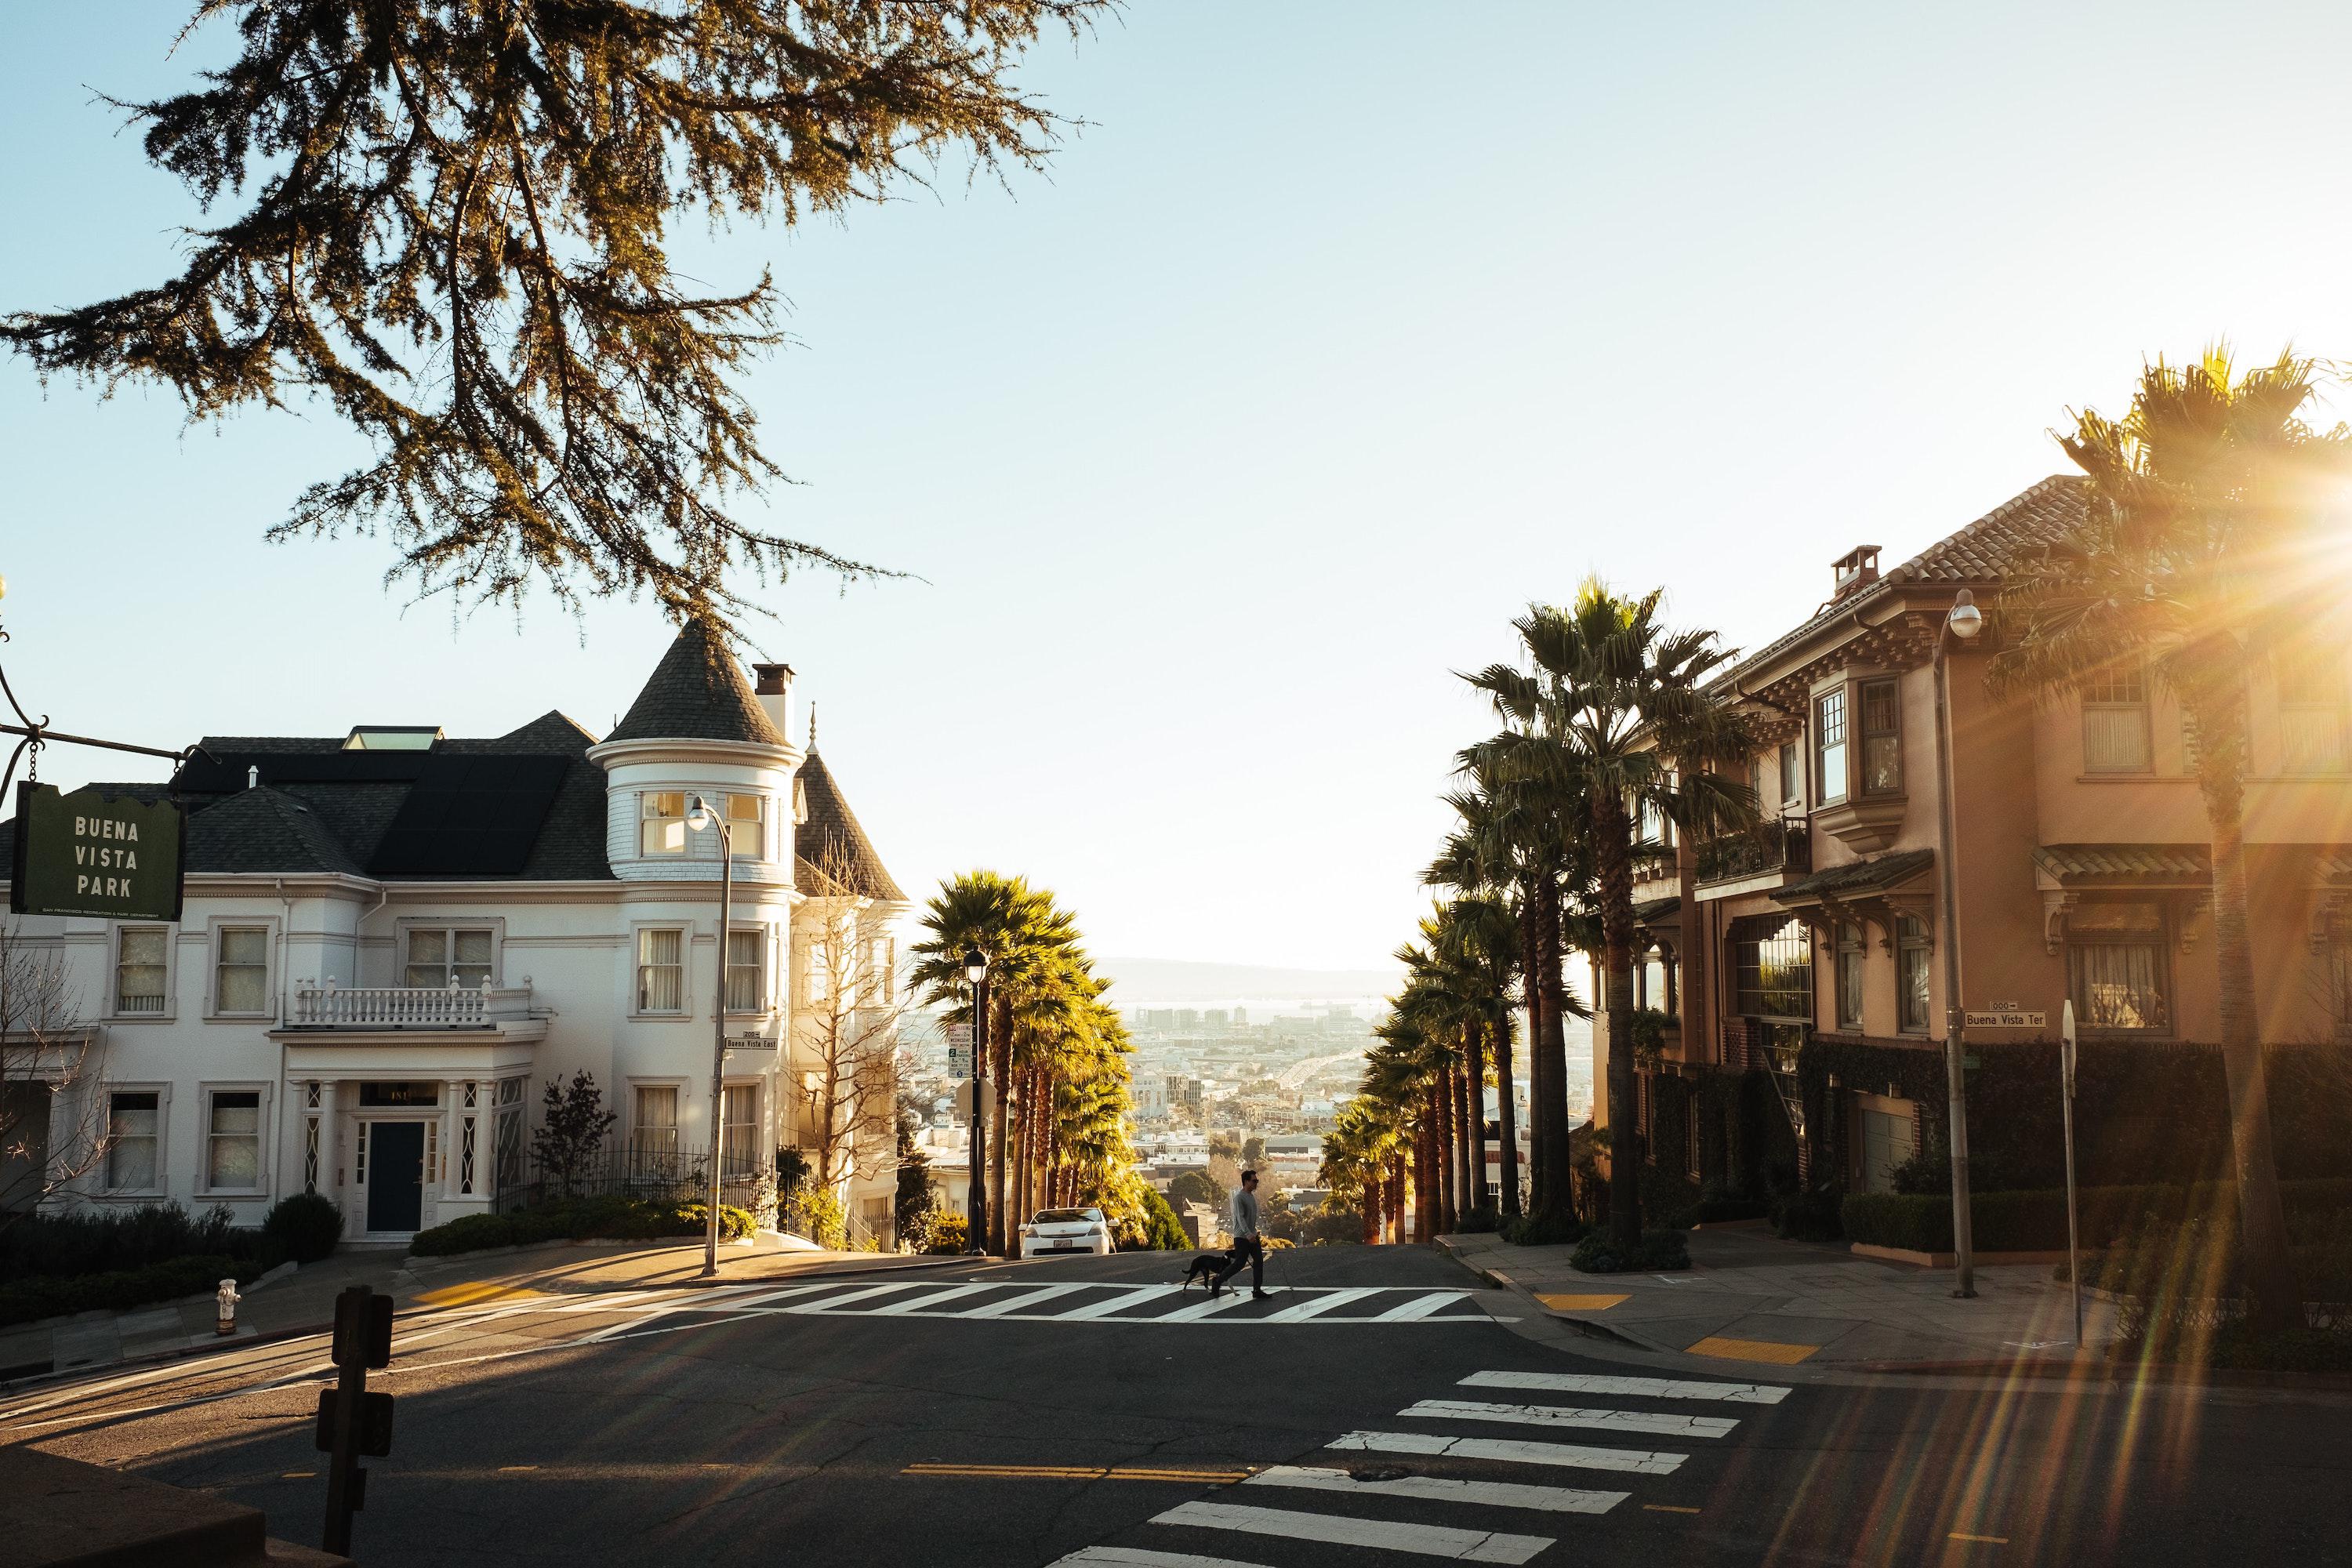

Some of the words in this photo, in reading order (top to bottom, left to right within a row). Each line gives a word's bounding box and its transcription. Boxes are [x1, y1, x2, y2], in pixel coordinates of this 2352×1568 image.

[75, 816, 137, 841] BUENA
[75, 845, 136, 869] VISTA
[77, 875, 131, 898] PARK
[1967, 1015, 1996, 1025] Buena
[2001, 1015, 2024, 1025] Vista
[2028, 1015, 2043, 1025] Ter
